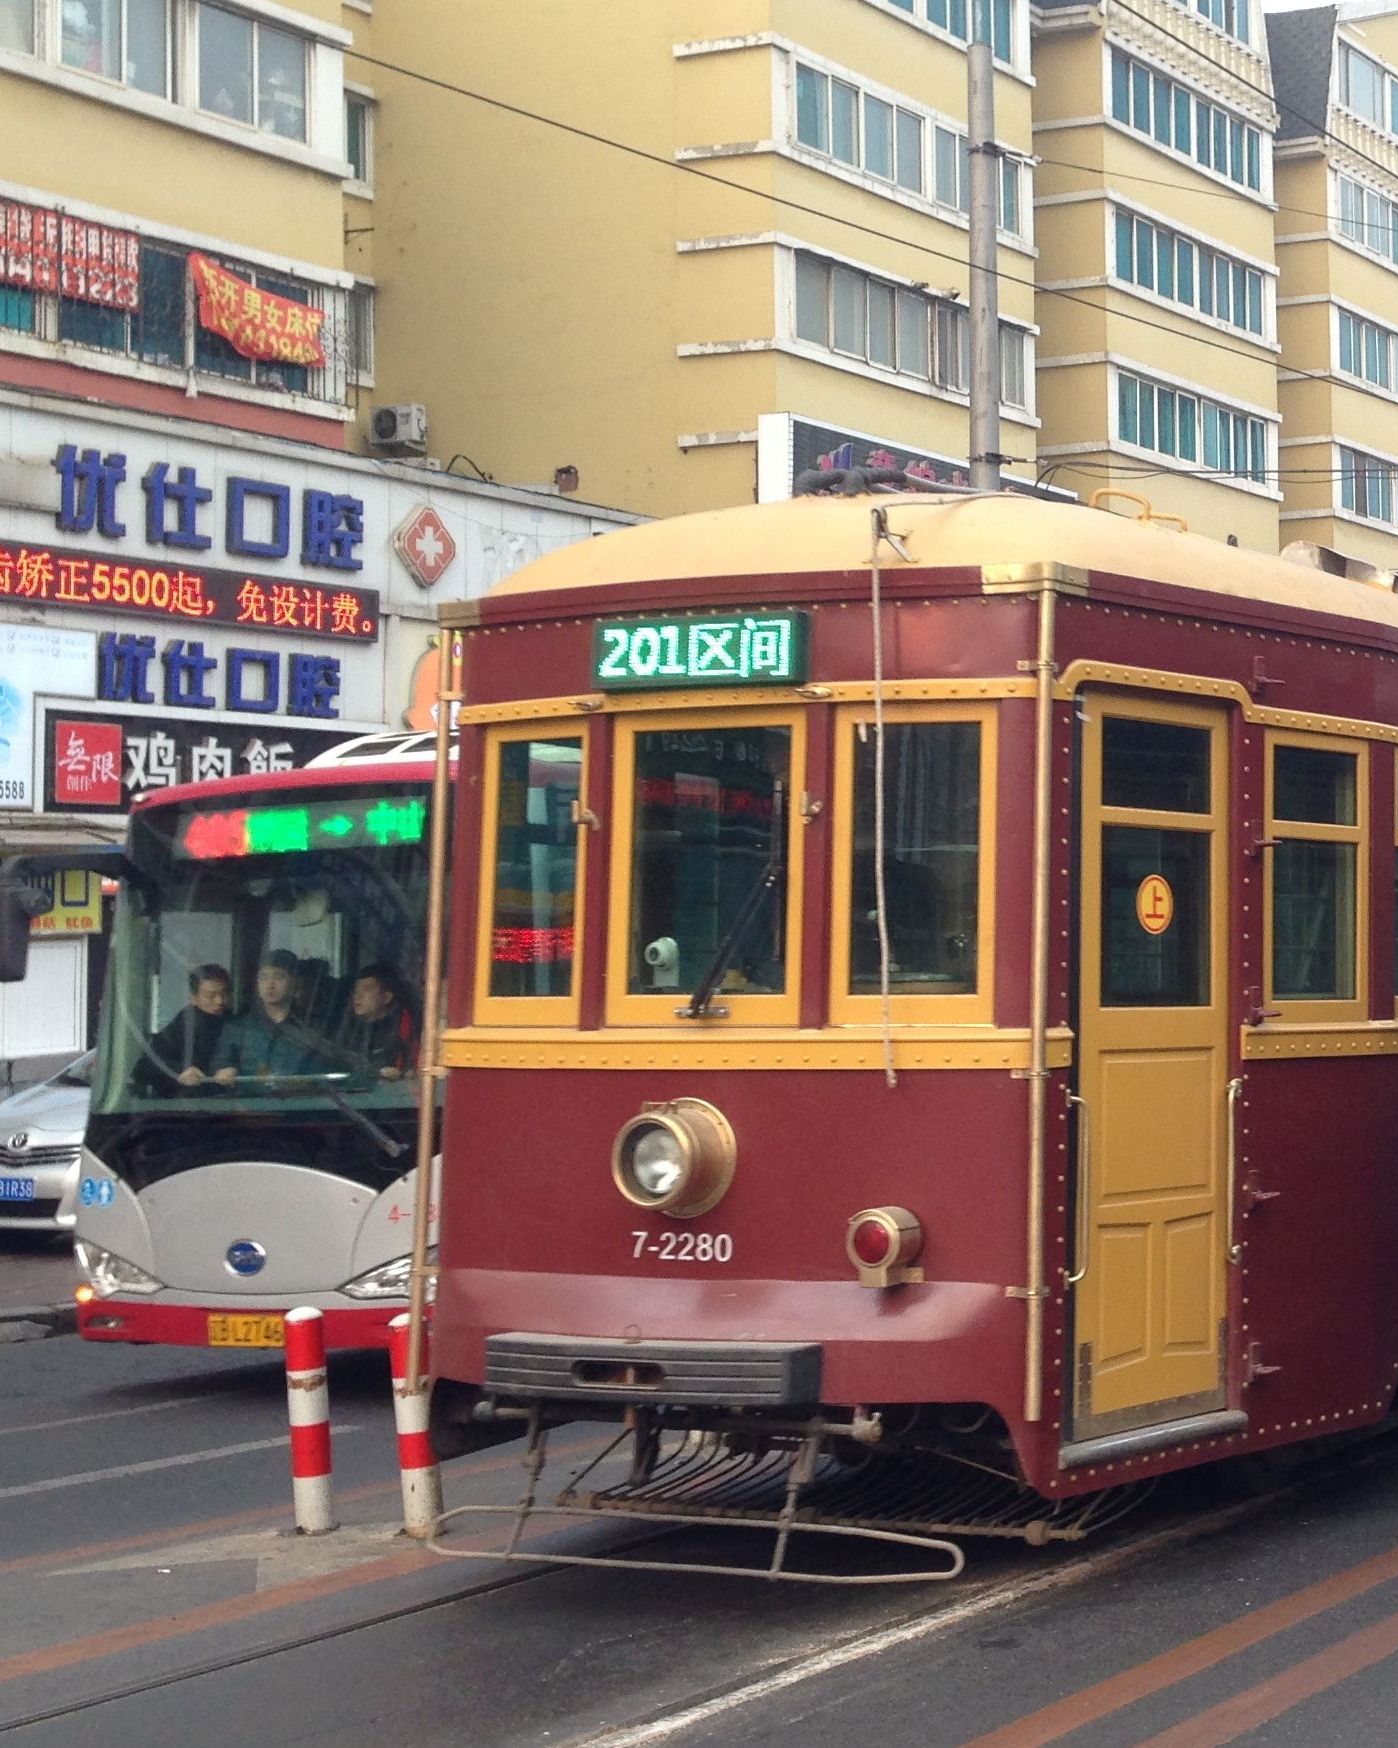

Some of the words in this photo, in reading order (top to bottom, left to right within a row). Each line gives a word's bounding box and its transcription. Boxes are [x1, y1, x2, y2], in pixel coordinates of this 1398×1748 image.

[52, 444, 365, 571] 优仕口腔
[100, 632, 342, 719] 优仕口腔
[598, 617, 791, 677] 201区间
[1144, 885, 1166, 919] 上
[631, 1230, 733, 1263] 7-2280
